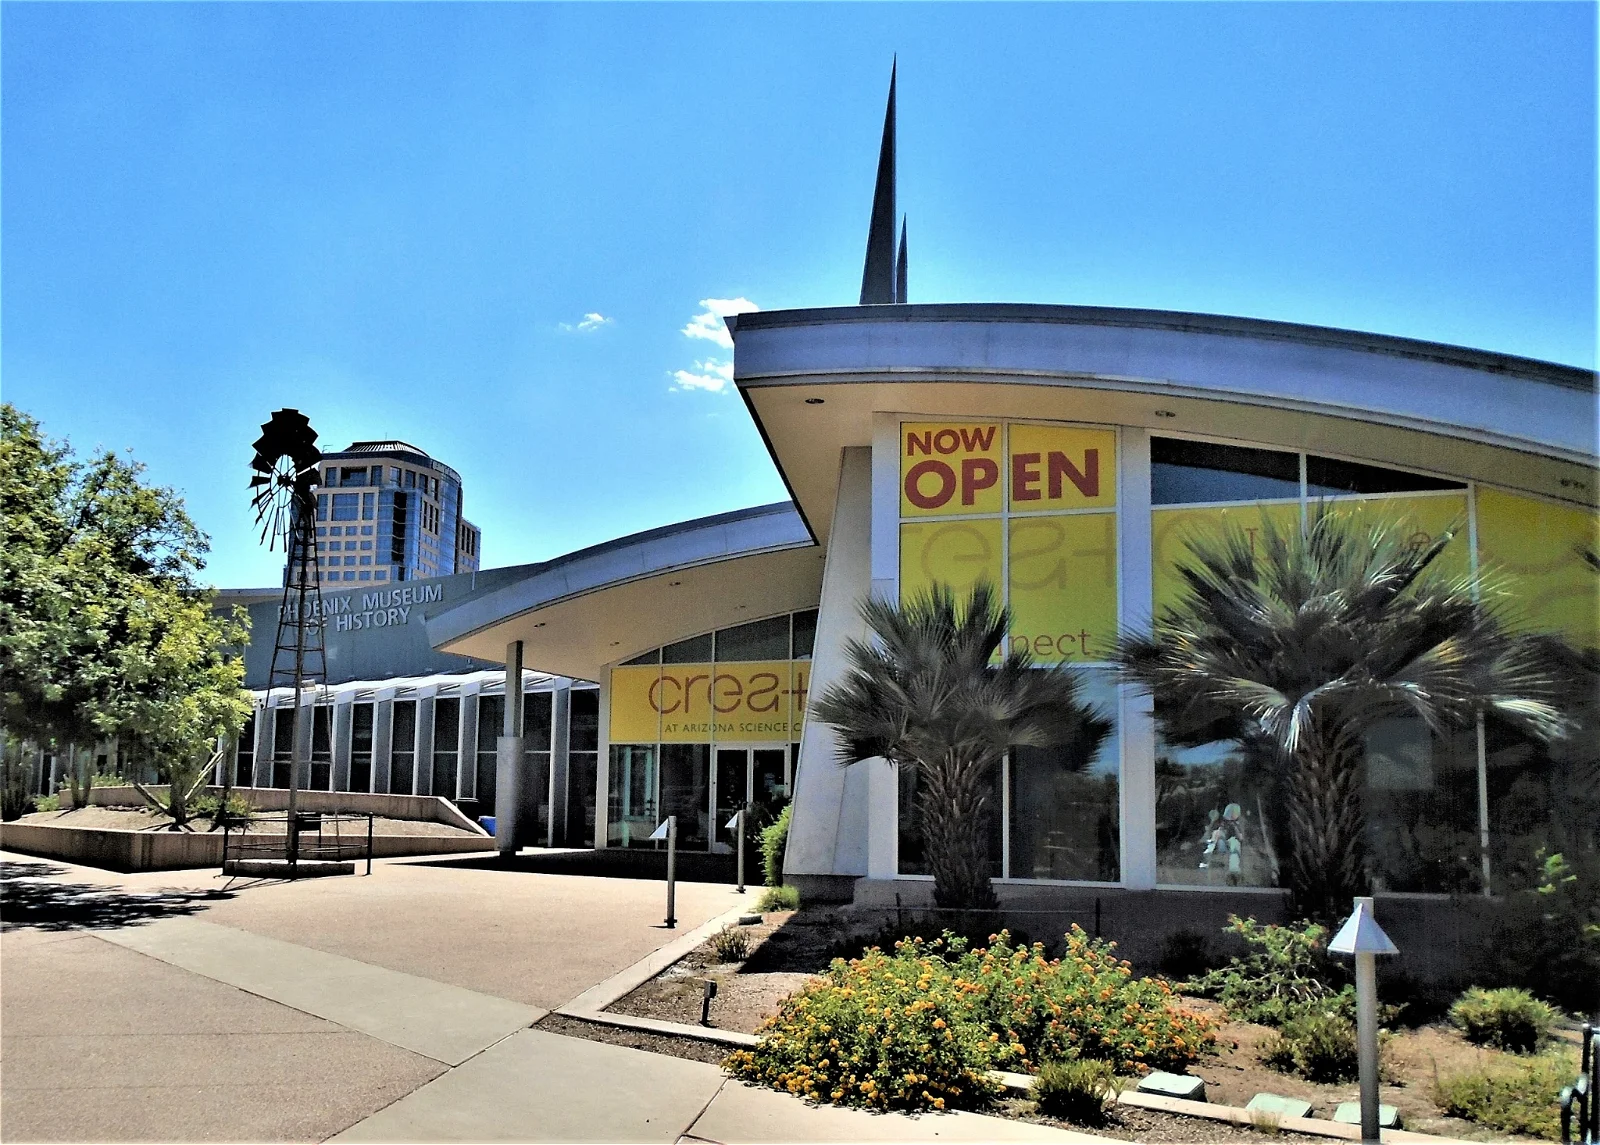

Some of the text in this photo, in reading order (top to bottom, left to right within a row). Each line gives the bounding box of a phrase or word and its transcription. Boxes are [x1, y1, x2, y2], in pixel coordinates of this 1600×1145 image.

[906, 426, 996, 456] NOW
[904, 448, 1099, 509] OPEN
[362, 584, 443, 612] MUSEUM
[336, 606, 412, 632] HISTORY
[665, 724, 678, 733] AT
[683, 722, 735, 733] ARIZONA
[740, 722, 788, 732] SCIENCE
